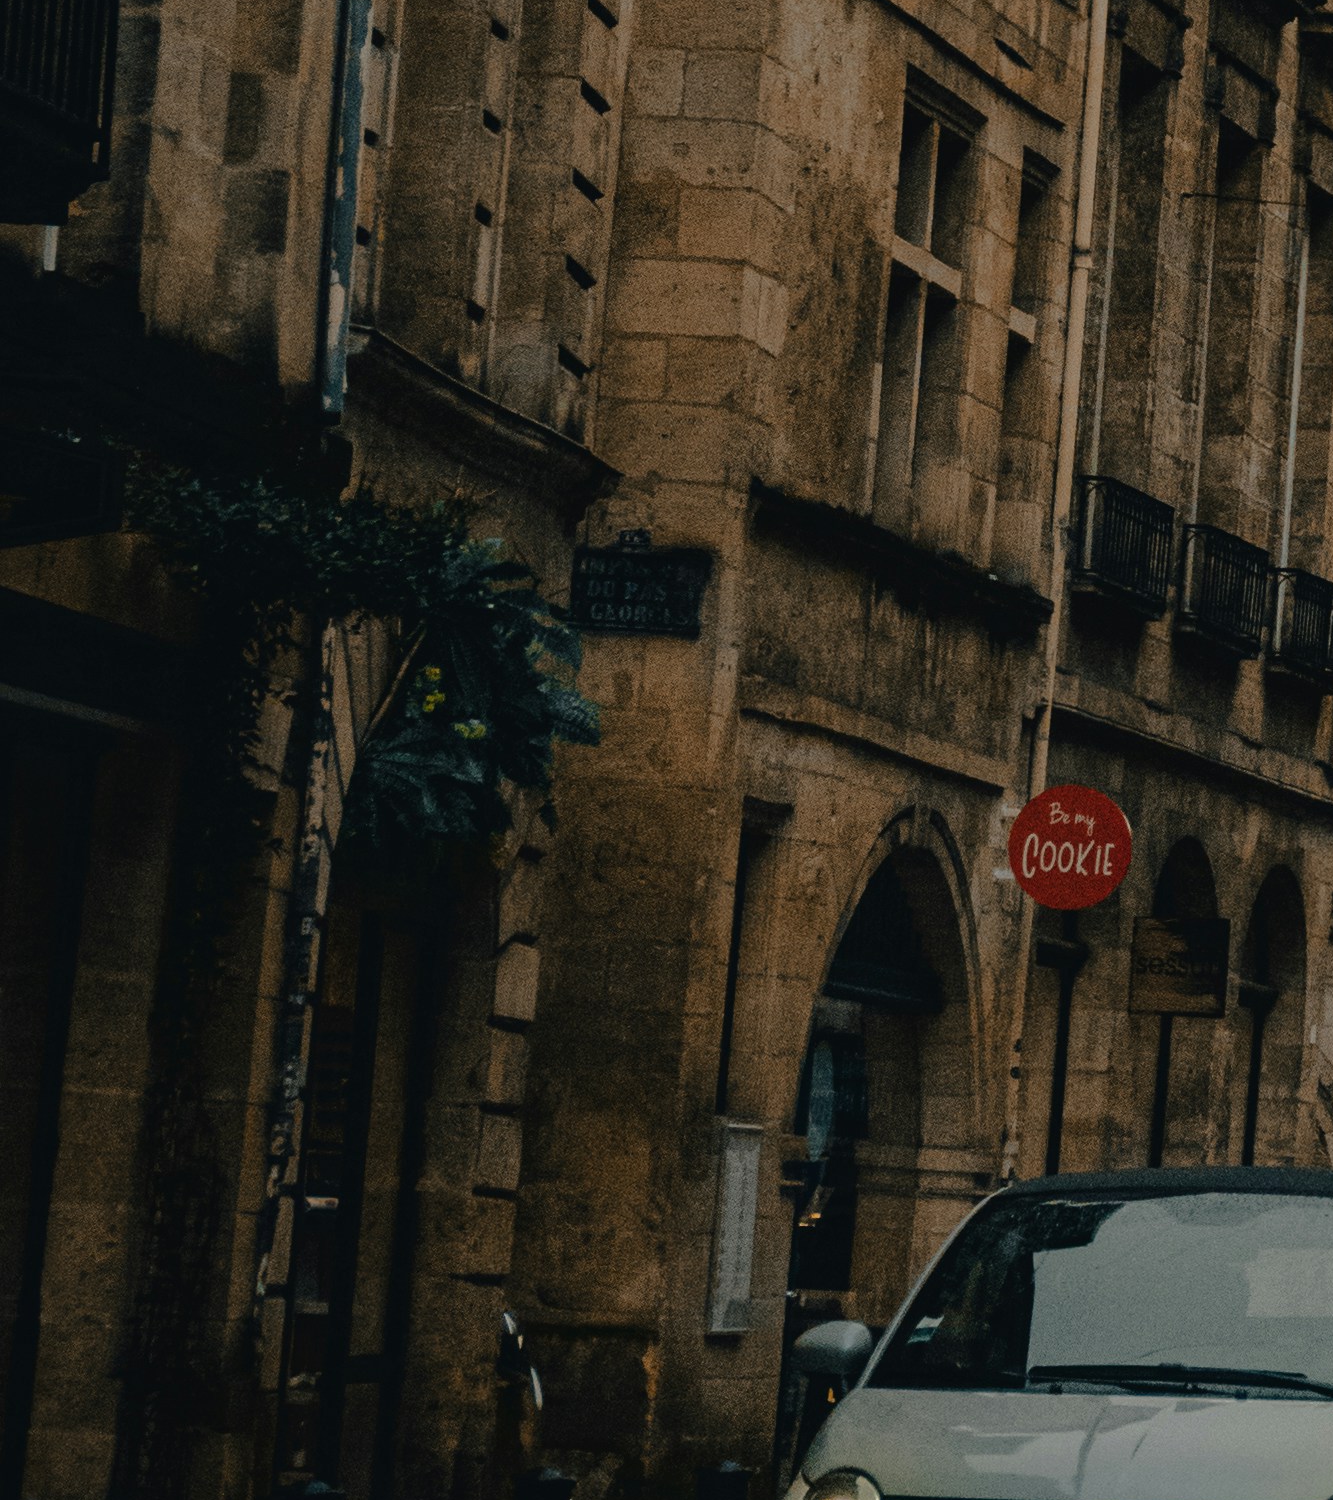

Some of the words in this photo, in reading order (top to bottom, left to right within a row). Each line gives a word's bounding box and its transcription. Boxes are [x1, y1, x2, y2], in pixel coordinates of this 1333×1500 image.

[1049, 801, 1071, 825] Be
[1074, 813, 1096, 836] my
[1021, 832, 1115, 879] COOKIE
